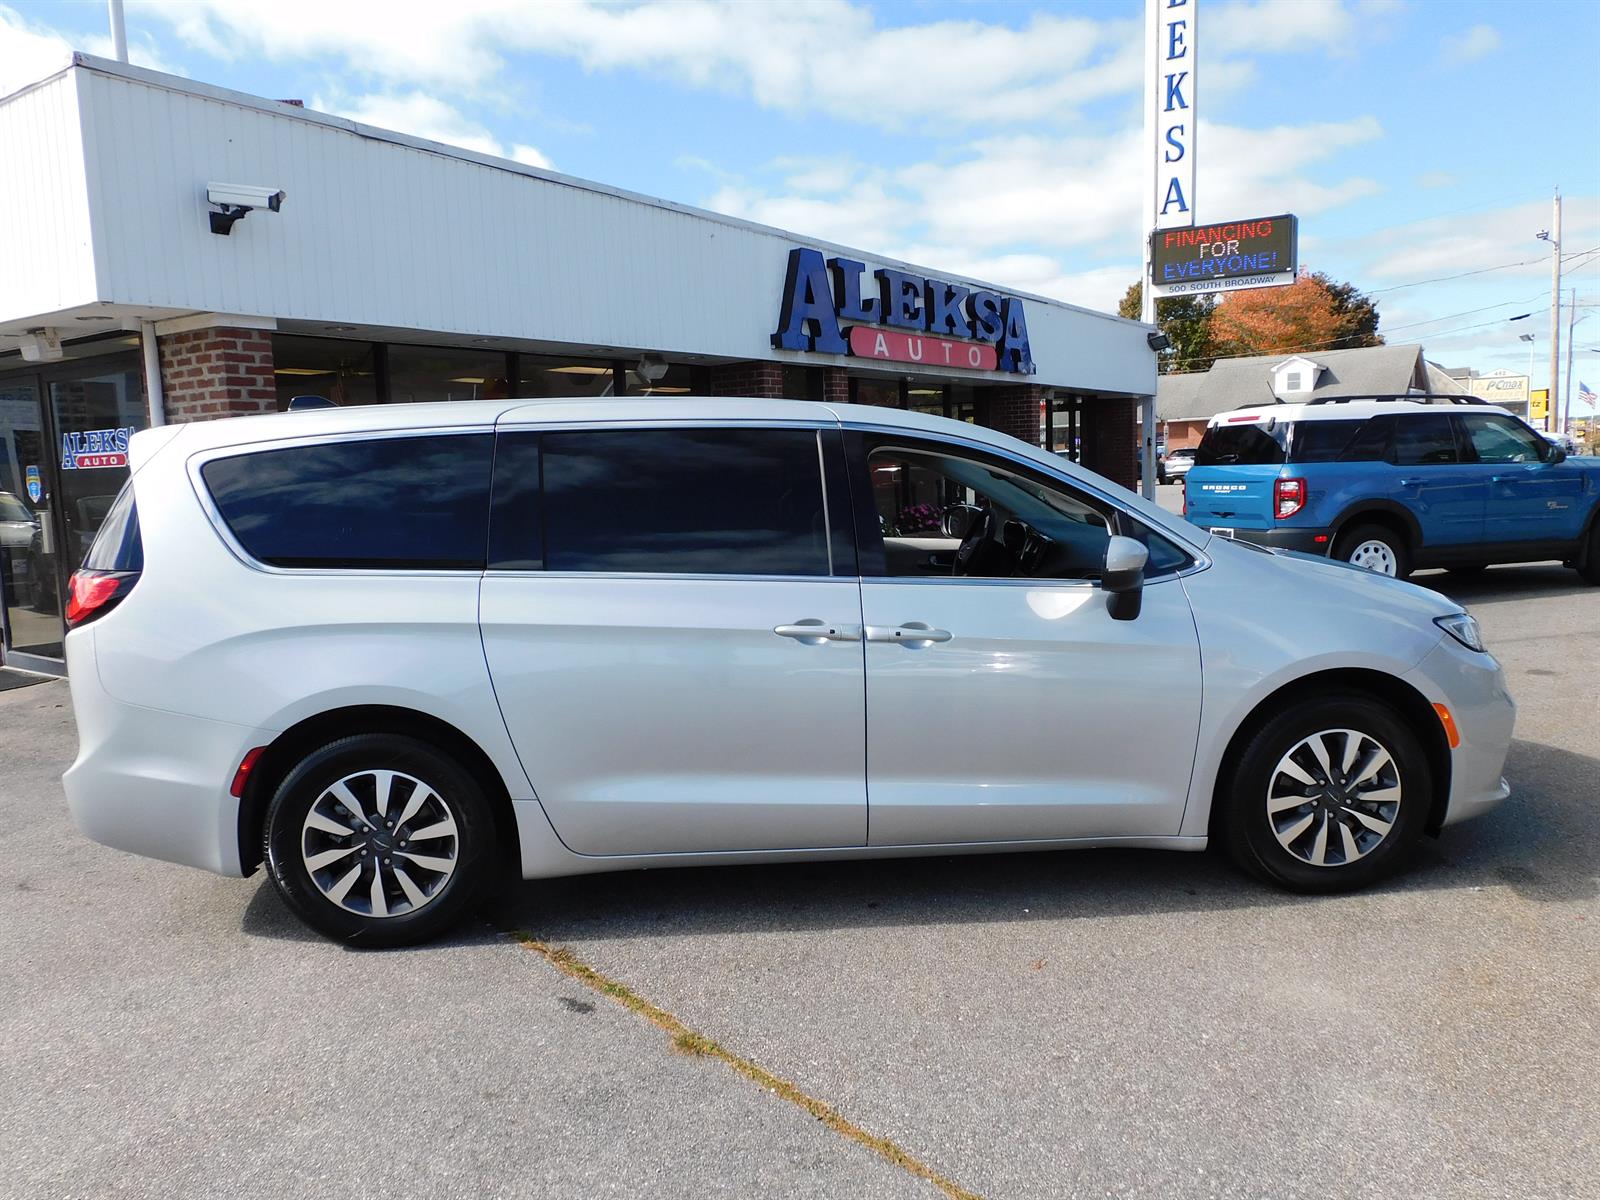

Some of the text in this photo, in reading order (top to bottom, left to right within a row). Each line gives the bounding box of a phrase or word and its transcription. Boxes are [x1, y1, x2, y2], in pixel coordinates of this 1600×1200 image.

[1160, 0, 1189, 215] EKSA
[1164, 220, 1273, 249] FINANCING
[1199, 239, 1240, 259] FOR
[1164, 251, 1278, 281] EVERYONE!
[1169, 275, 1276, 294] 500 SOUTH BROADWAY
[770, 247, 1037, 375] ALEKSA
[873, 332, 982, 367] AUTO
[83, 456, 118, 466] AUTO
